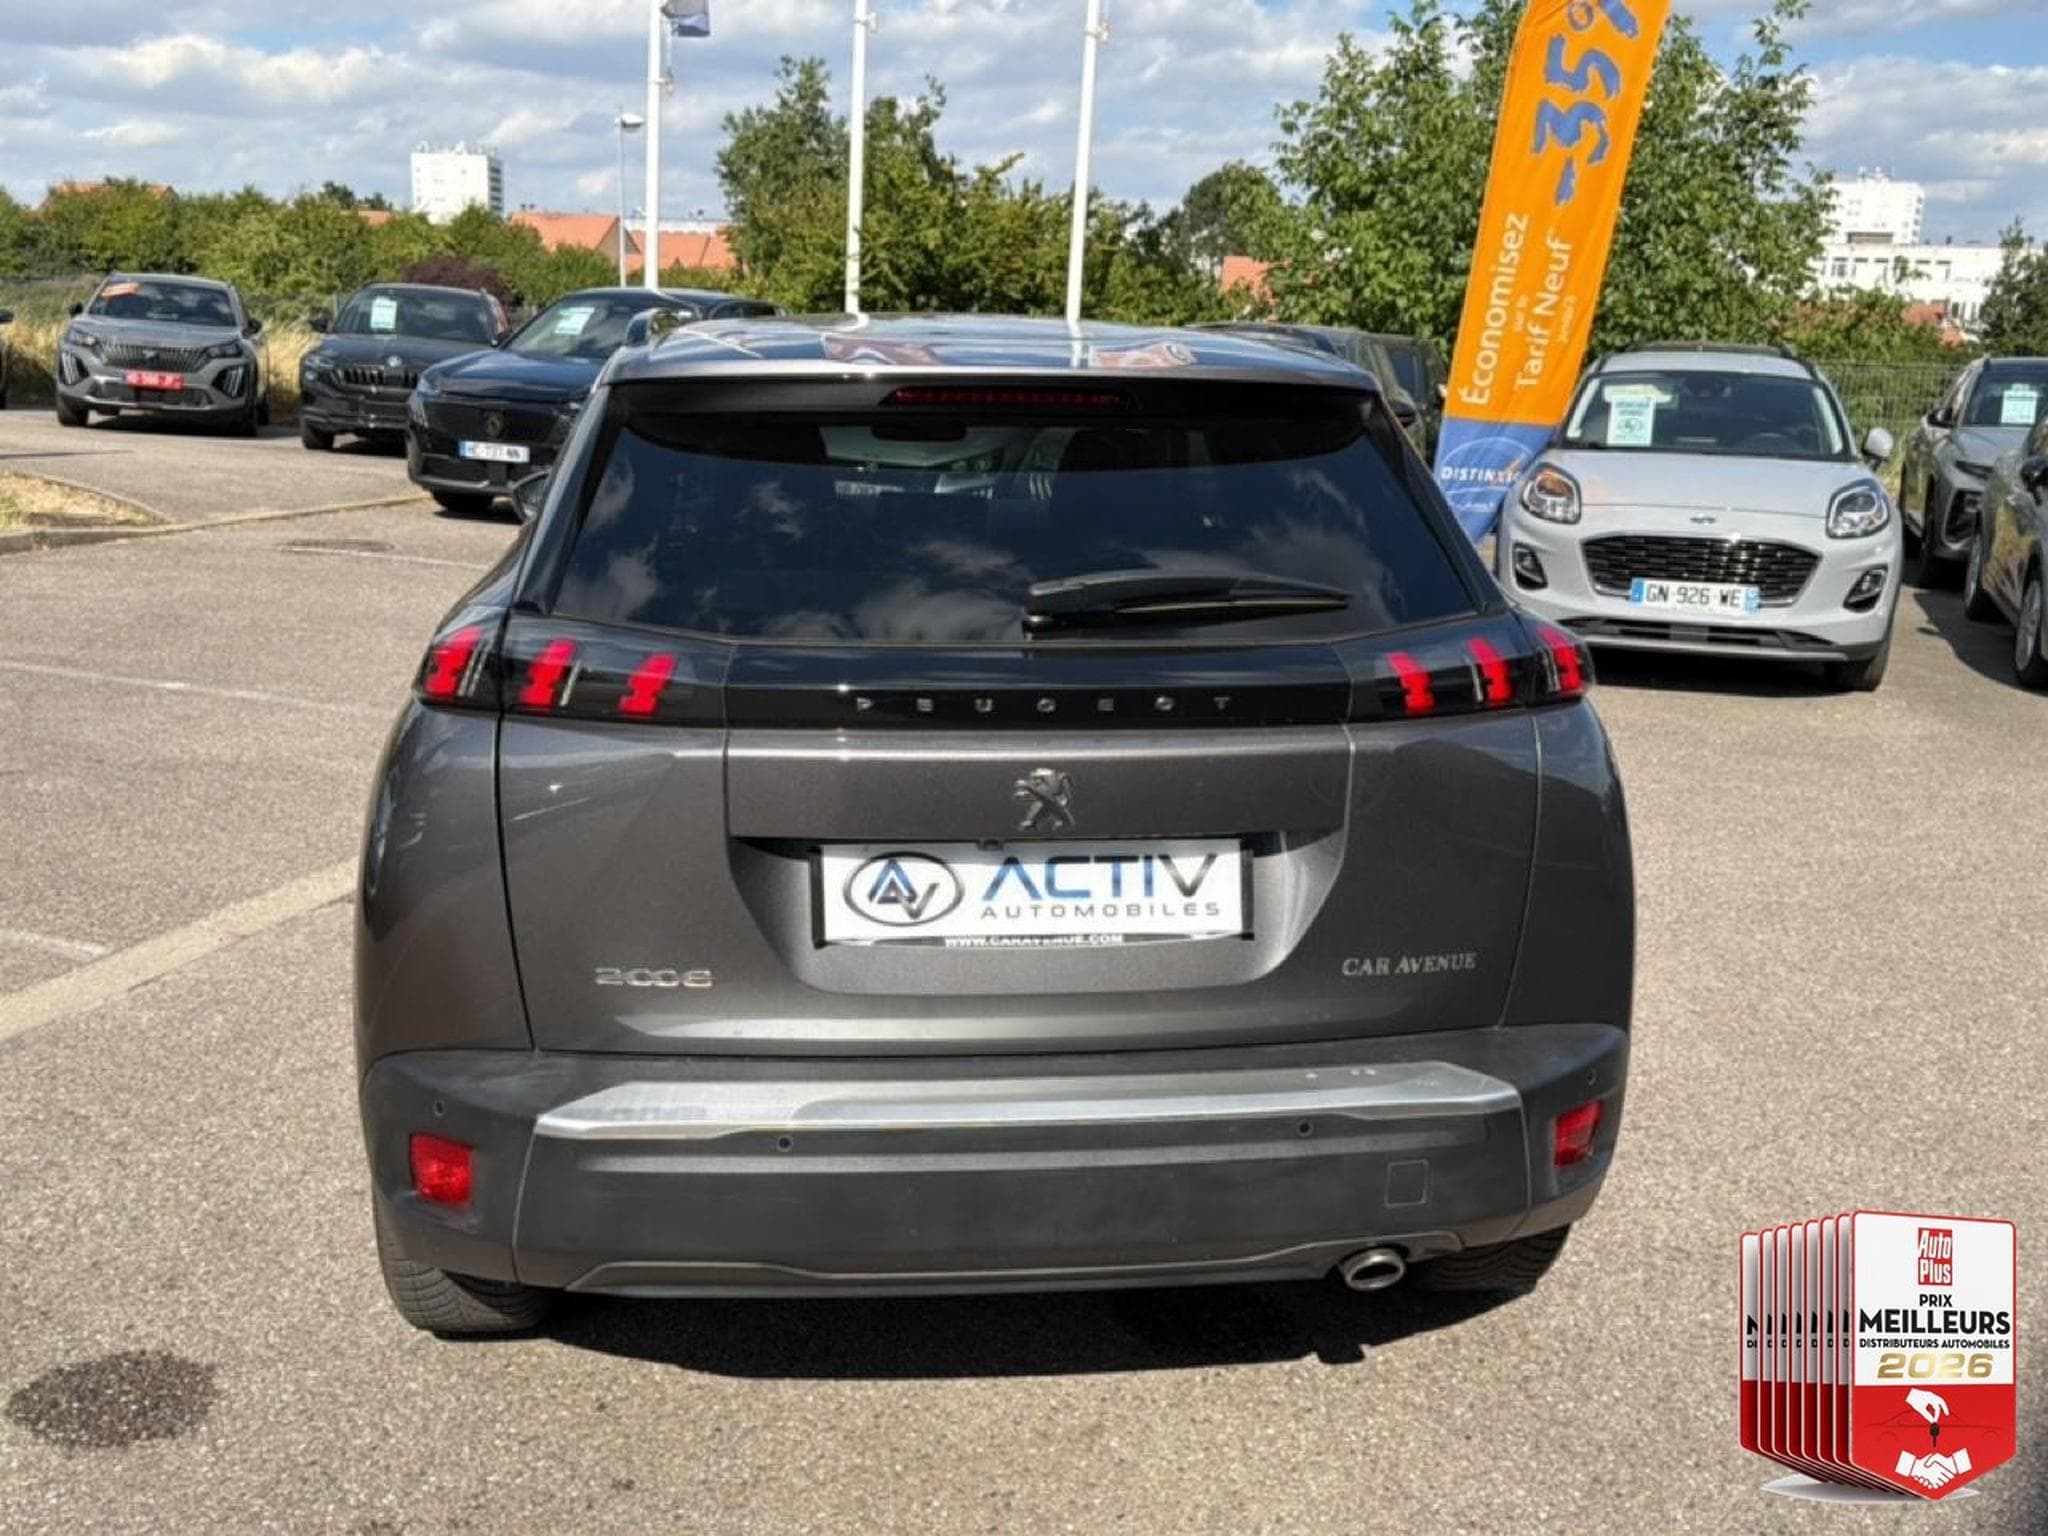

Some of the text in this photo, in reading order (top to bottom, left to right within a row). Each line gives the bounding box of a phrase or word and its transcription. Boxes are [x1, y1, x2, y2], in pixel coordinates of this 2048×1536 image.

[1458, 212, 1529, 406] Économisez
[1516, 228, 1573, 387] Tarif Neuf
[856, 696, 1231, 714] PEUGEOT
[980, 853, 1218, 901] ACTIV
[980, 901, 1221, 920] AUTOMOBILES
[1341, 952, 1478, 976] CAR AVENUE
